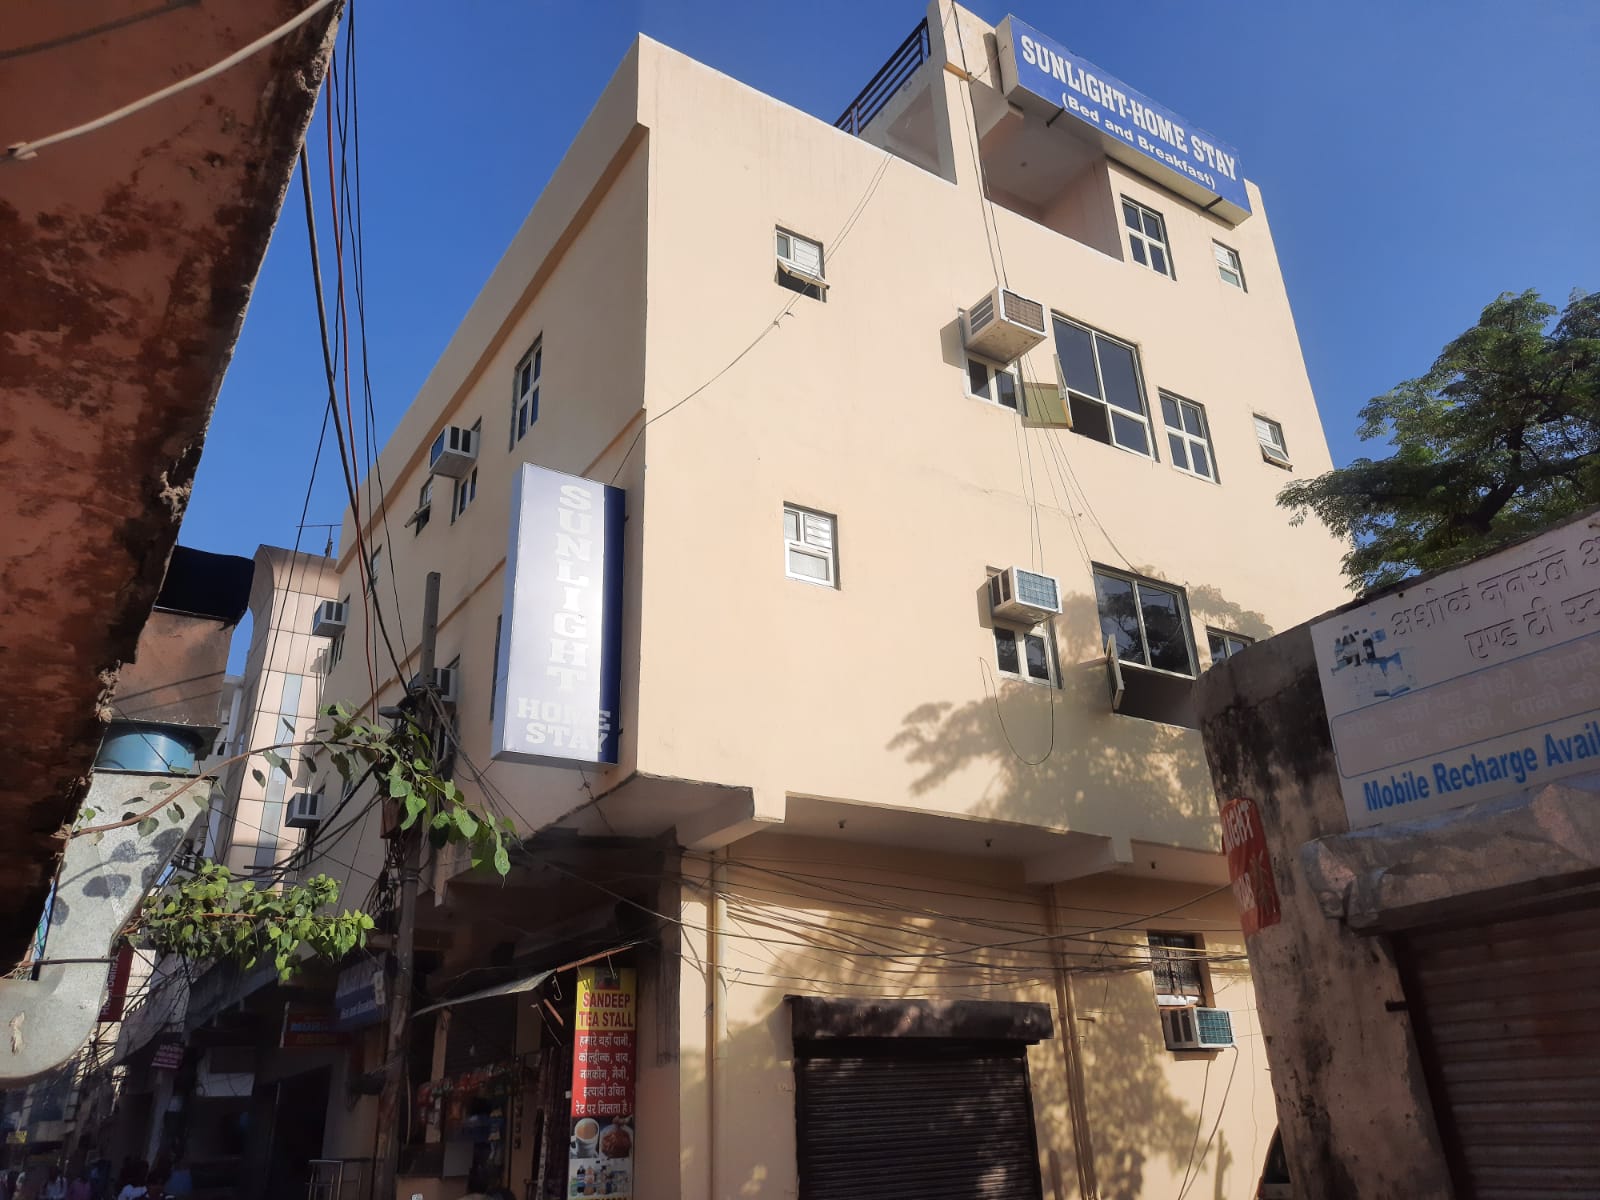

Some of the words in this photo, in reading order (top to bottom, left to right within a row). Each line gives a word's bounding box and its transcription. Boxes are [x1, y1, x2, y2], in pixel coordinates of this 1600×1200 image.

[1062, 92, 1100, 124] (Bed
[1104, 119, 1133, 142] and
[1138, 135, 1216, 190] Breakfast)
[1191, 135, 1236, 181] STAY
[525, 722, 608, 753] STAY
[1363, 771, 1430, 812] Mobile
[1432, 746, 1538, 795] Recharge
[578, 1011, 600, 1027] TEA
[602, 1012, 634, 1028] STALL
[583, 992, 631, 1009] SANDEEP
